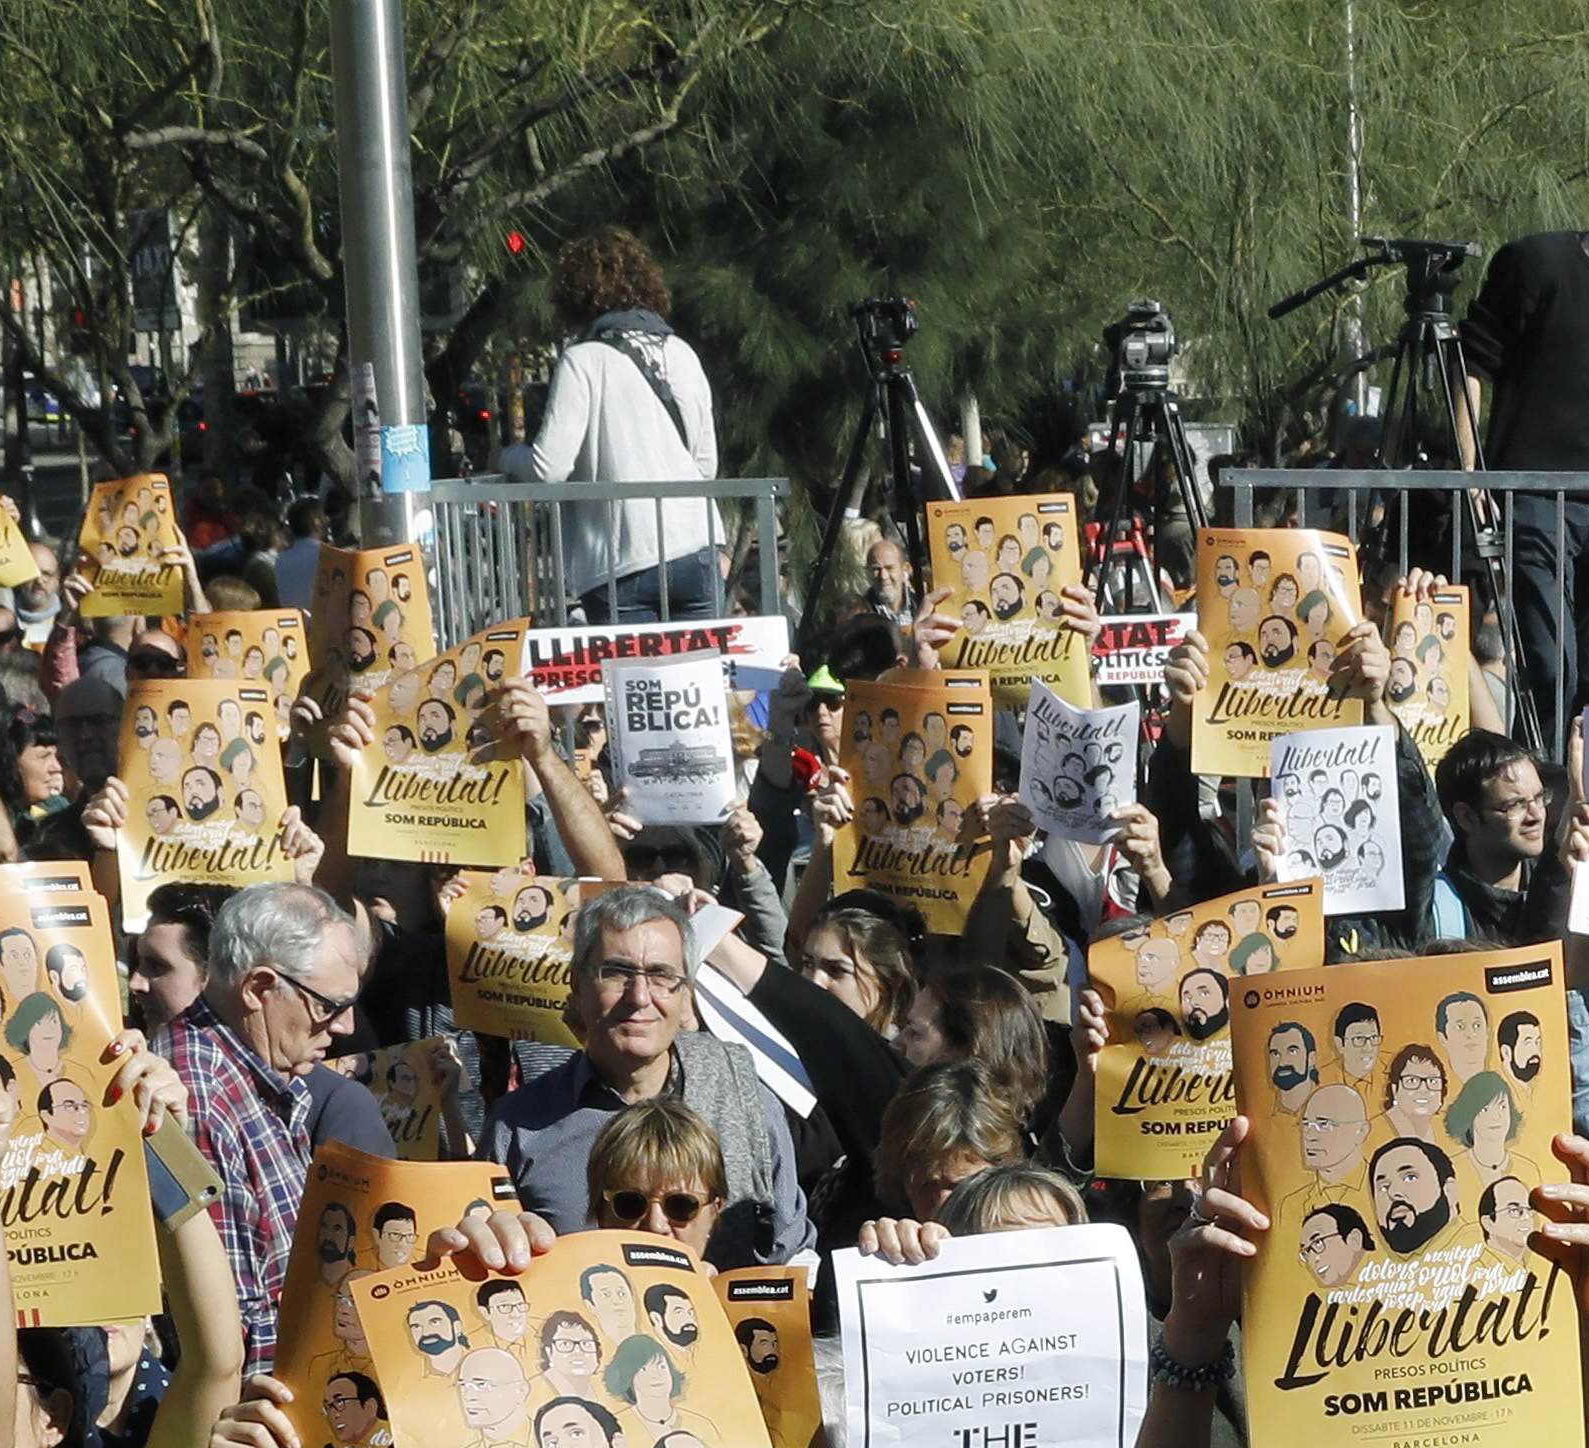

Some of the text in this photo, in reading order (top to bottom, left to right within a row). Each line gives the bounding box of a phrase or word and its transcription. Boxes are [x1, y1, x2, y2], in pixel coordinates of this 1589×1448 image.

[530, 625, 732, 668] LLIBERTAT
[626, 679, 661, 691] SOM
[626, 684, 702, 712] REPÚ
[628, 705, 720, 732] BLICA!
[1279, 727, 1379, 771] Llibertat!
[363, 762, 504, 811] Llibertat!
[385, 814, 487, 829] SOM REPÚBLICA
[947, 1307, 1032, 1326] #empaperem
[1274, 1260, 1560, 1391] Llibertat!
[906, 1335, 1078, 1364] VIOLENCE AGAINST
[952, 1366, 1025, 1385] VOTERS!
[887, 1384, 1089, 1417] POLITICAL PRISONERS!
[1324, 1374, 1532, 1416] SOM REPÚBLICA
